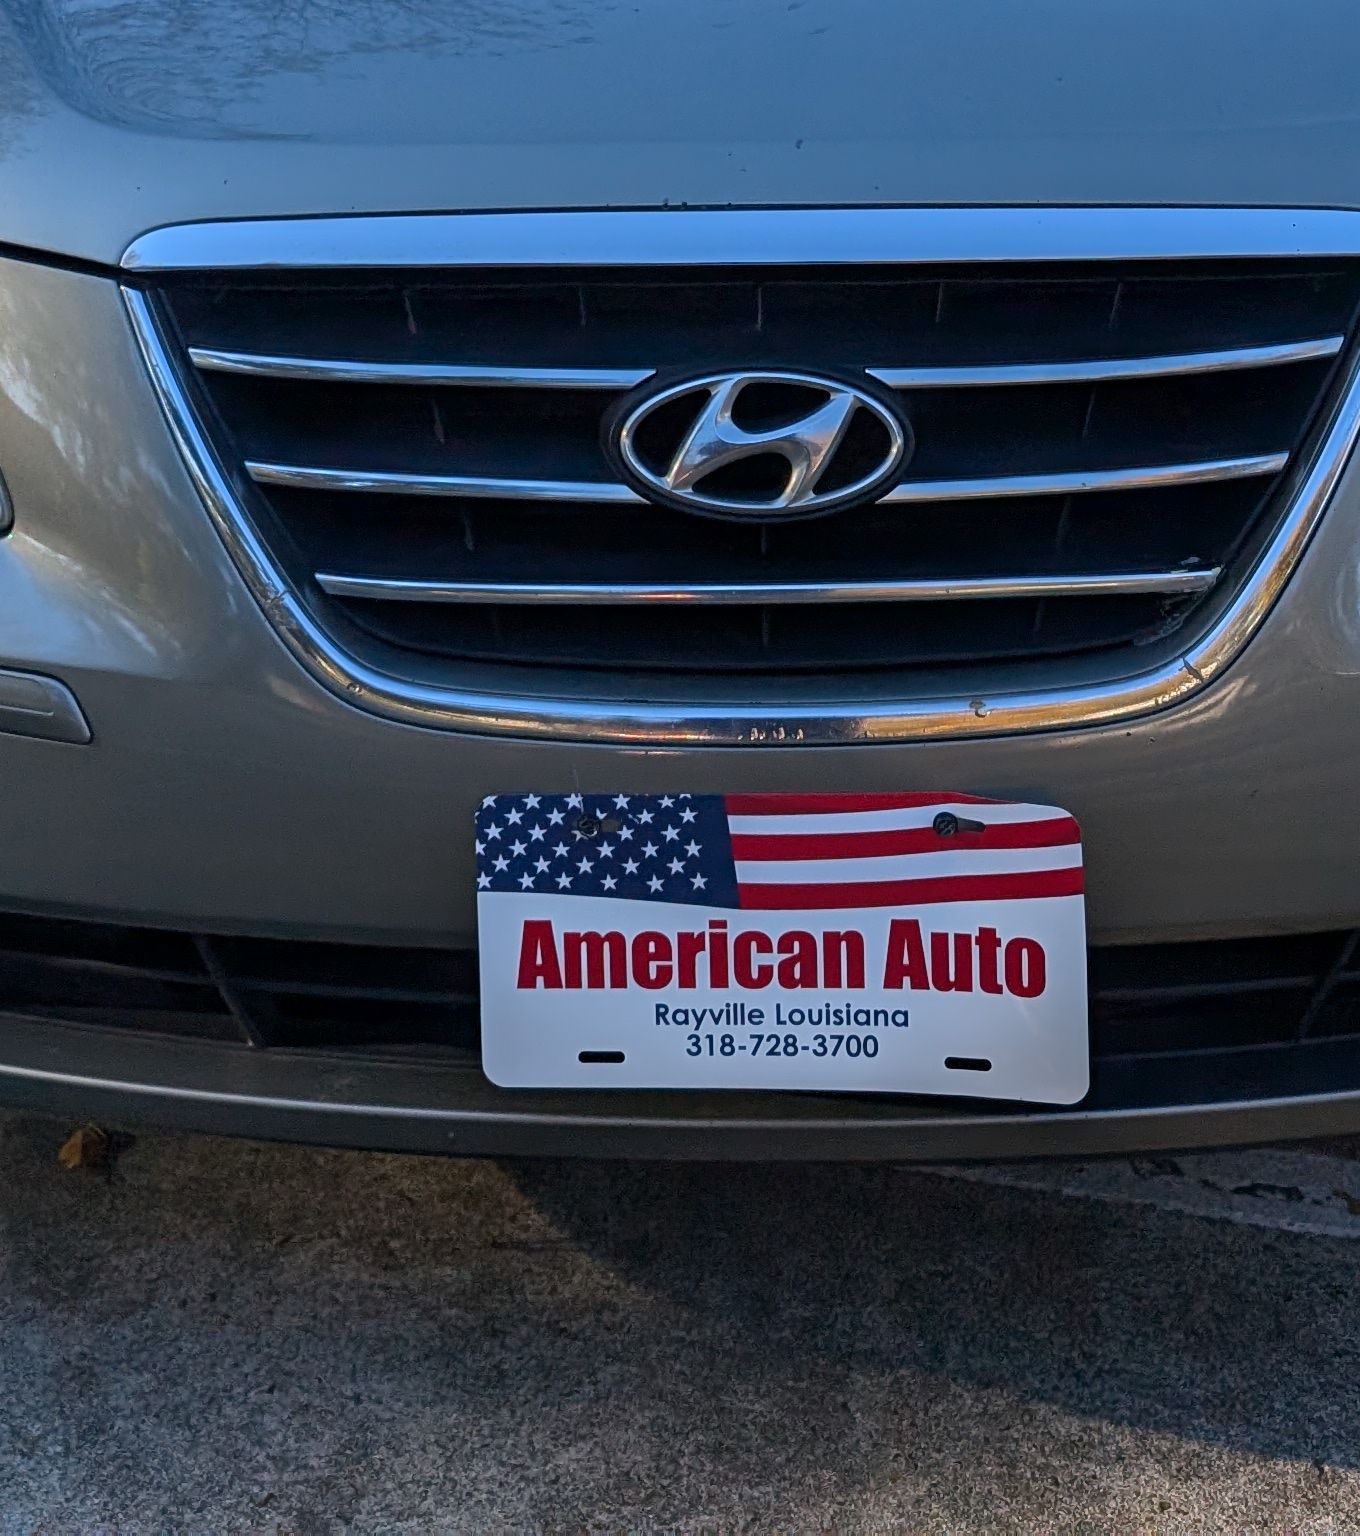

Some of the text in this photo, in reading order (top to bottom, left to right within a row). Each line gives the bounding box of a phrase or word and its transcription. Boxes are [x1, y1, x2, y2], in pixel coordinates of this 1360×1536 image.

[517, 919, 1046, 998] American Auto
[654, 1002, 910, 1032] Rayville Louisiana
[685, 1033, 880, 1059] 318-728-3700
